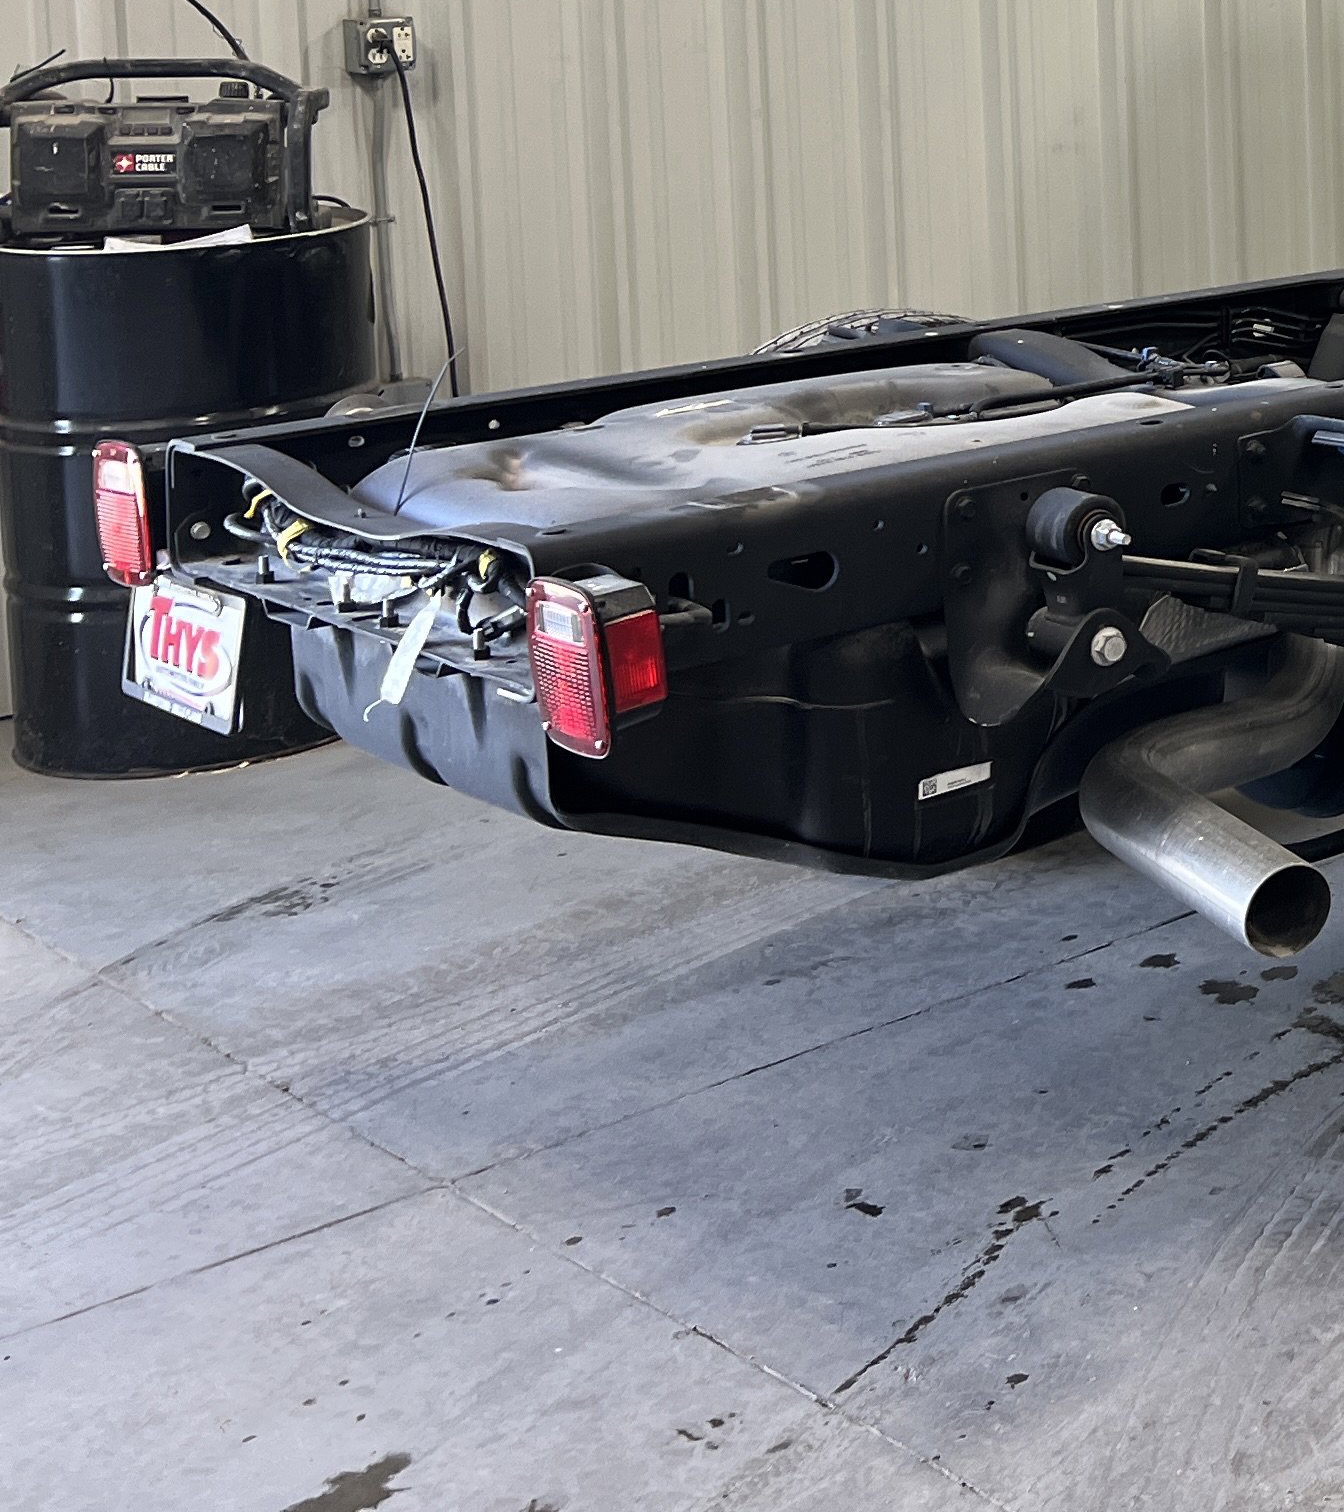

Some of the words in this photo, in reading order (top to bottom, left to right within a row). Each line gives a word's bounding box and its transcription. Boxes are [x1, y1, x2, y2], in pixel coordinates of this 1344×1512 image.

[135, 153, 174, 163] PORTER
[135, 162, 166, 172] CABLE
[149, 594, 222, 680] THYS
